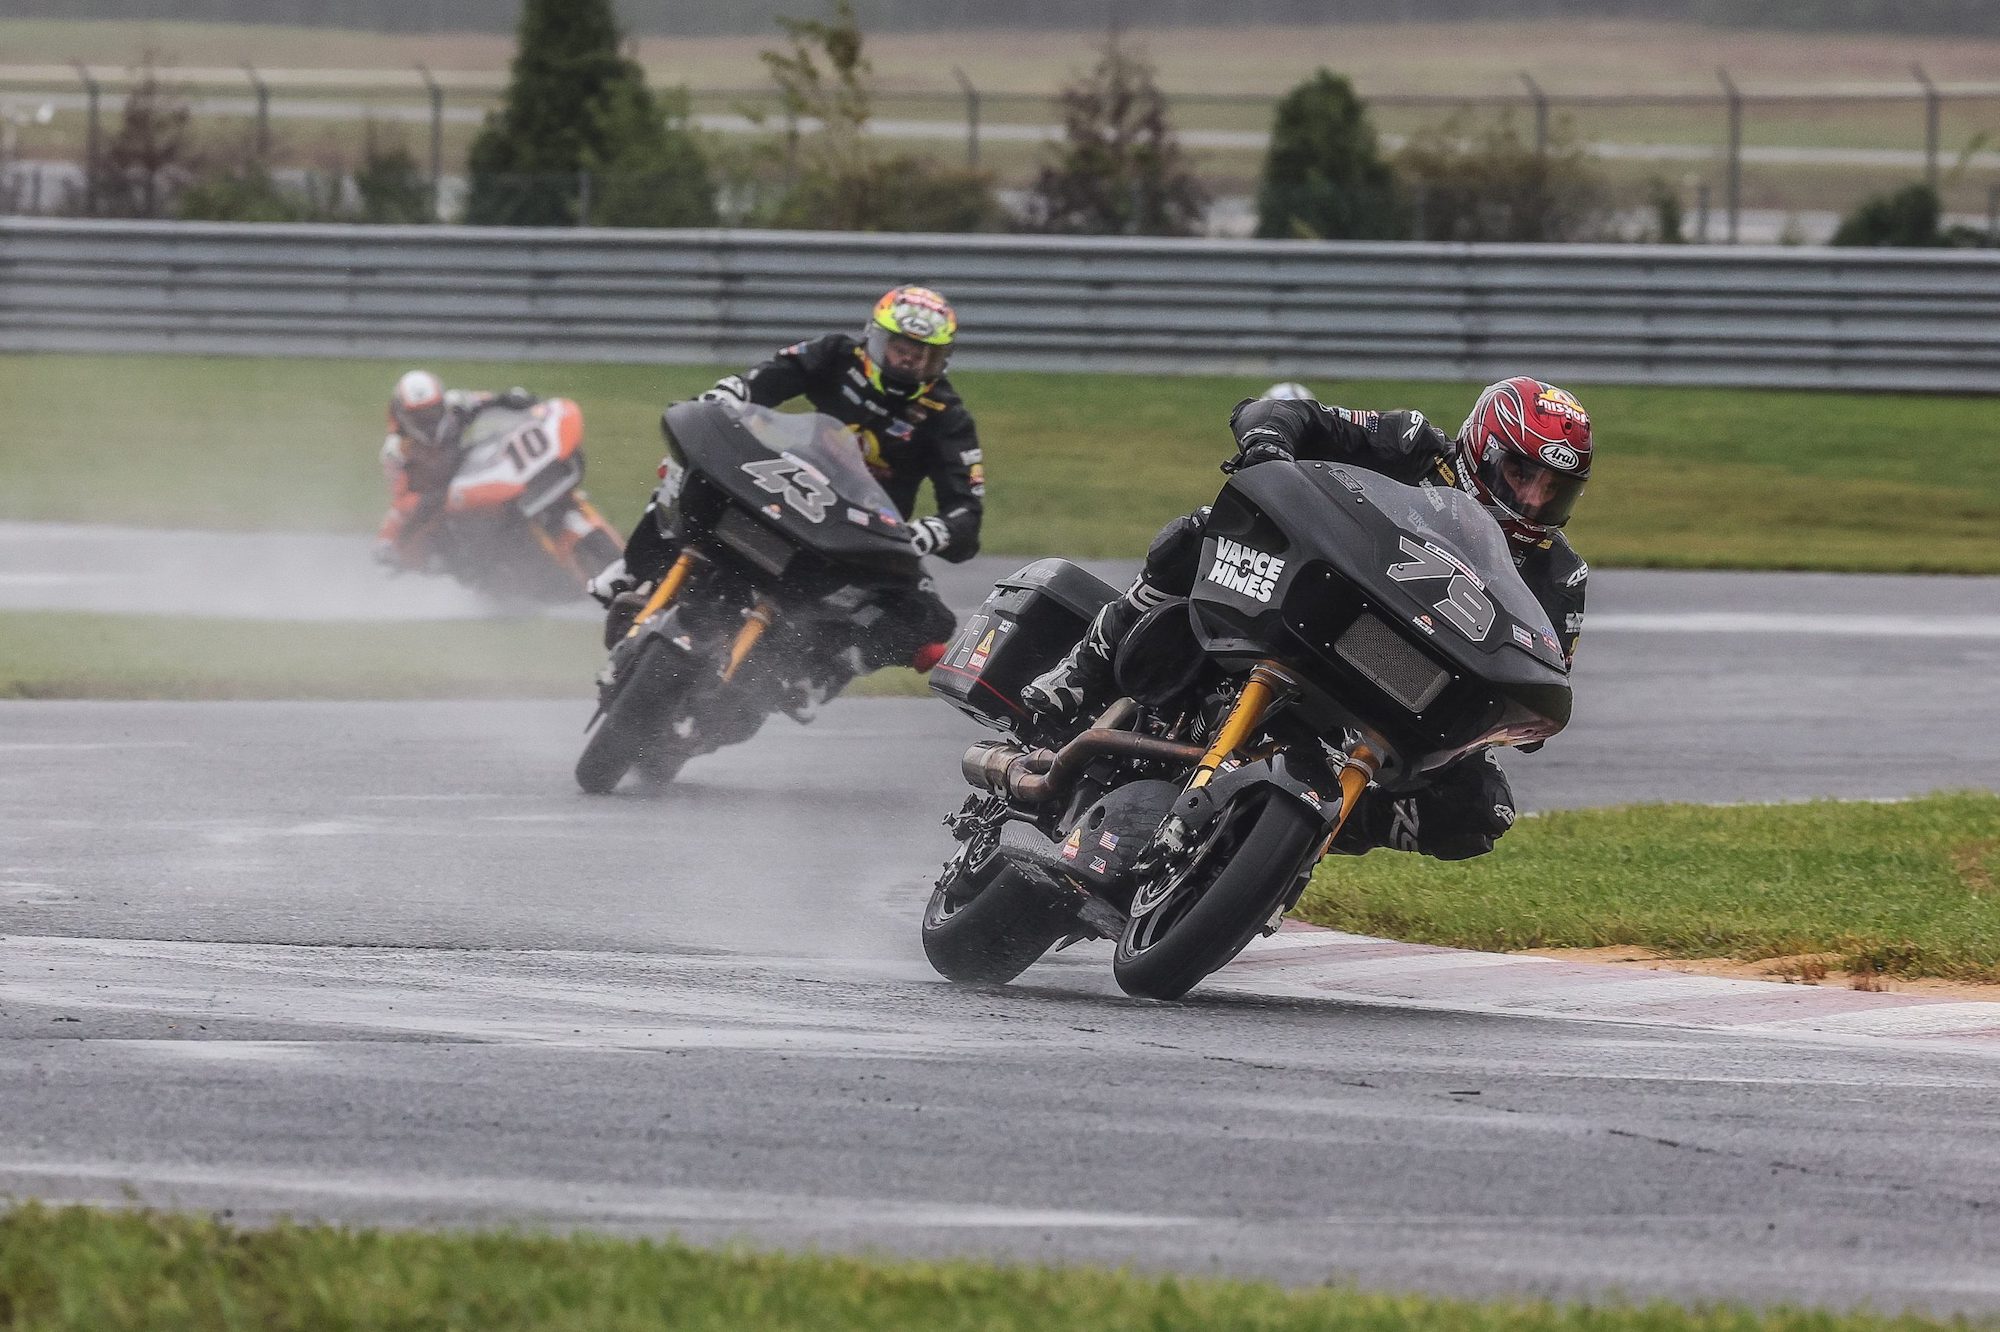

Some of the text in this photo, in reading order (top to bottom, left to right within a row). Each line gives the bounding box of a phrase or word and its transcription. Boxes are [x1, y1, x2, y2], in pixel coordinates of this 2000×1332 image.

[506, 428, 549, 471] 10
[1543, 447, 1574, 465] Arai
[1216, 535, 1286, 582] VANCE
[1208, 559, 1276, 603] HINES
[1386, 535, 1496, 641] 79
